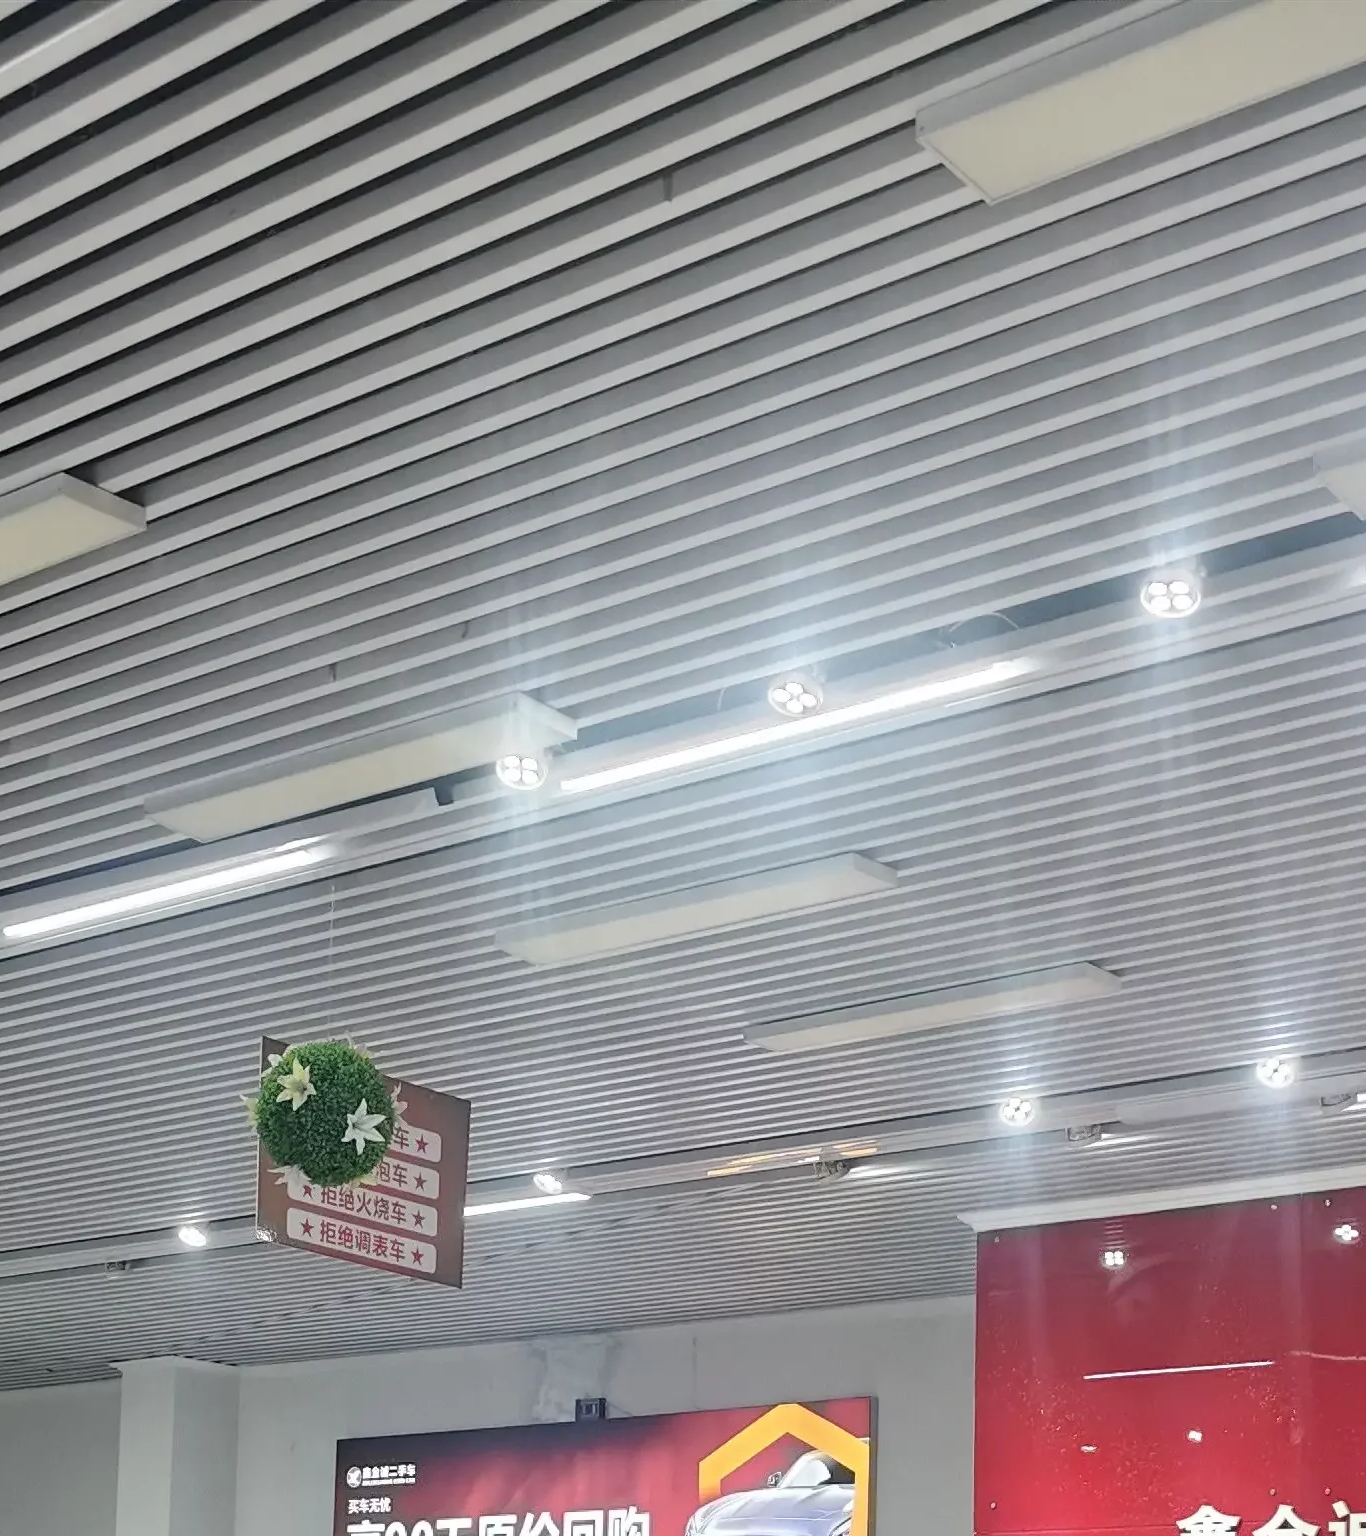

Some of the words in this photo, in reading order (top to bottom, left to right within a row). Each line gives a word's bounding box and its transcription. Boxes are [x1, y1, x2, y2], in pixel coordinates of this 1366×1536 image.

[321, 1187, 406, 1224] 拒绝火烧车
[320, 1220, 405, 1263] 拒绝调表车
[348, 1498, 391, 1514] 买车无忧
